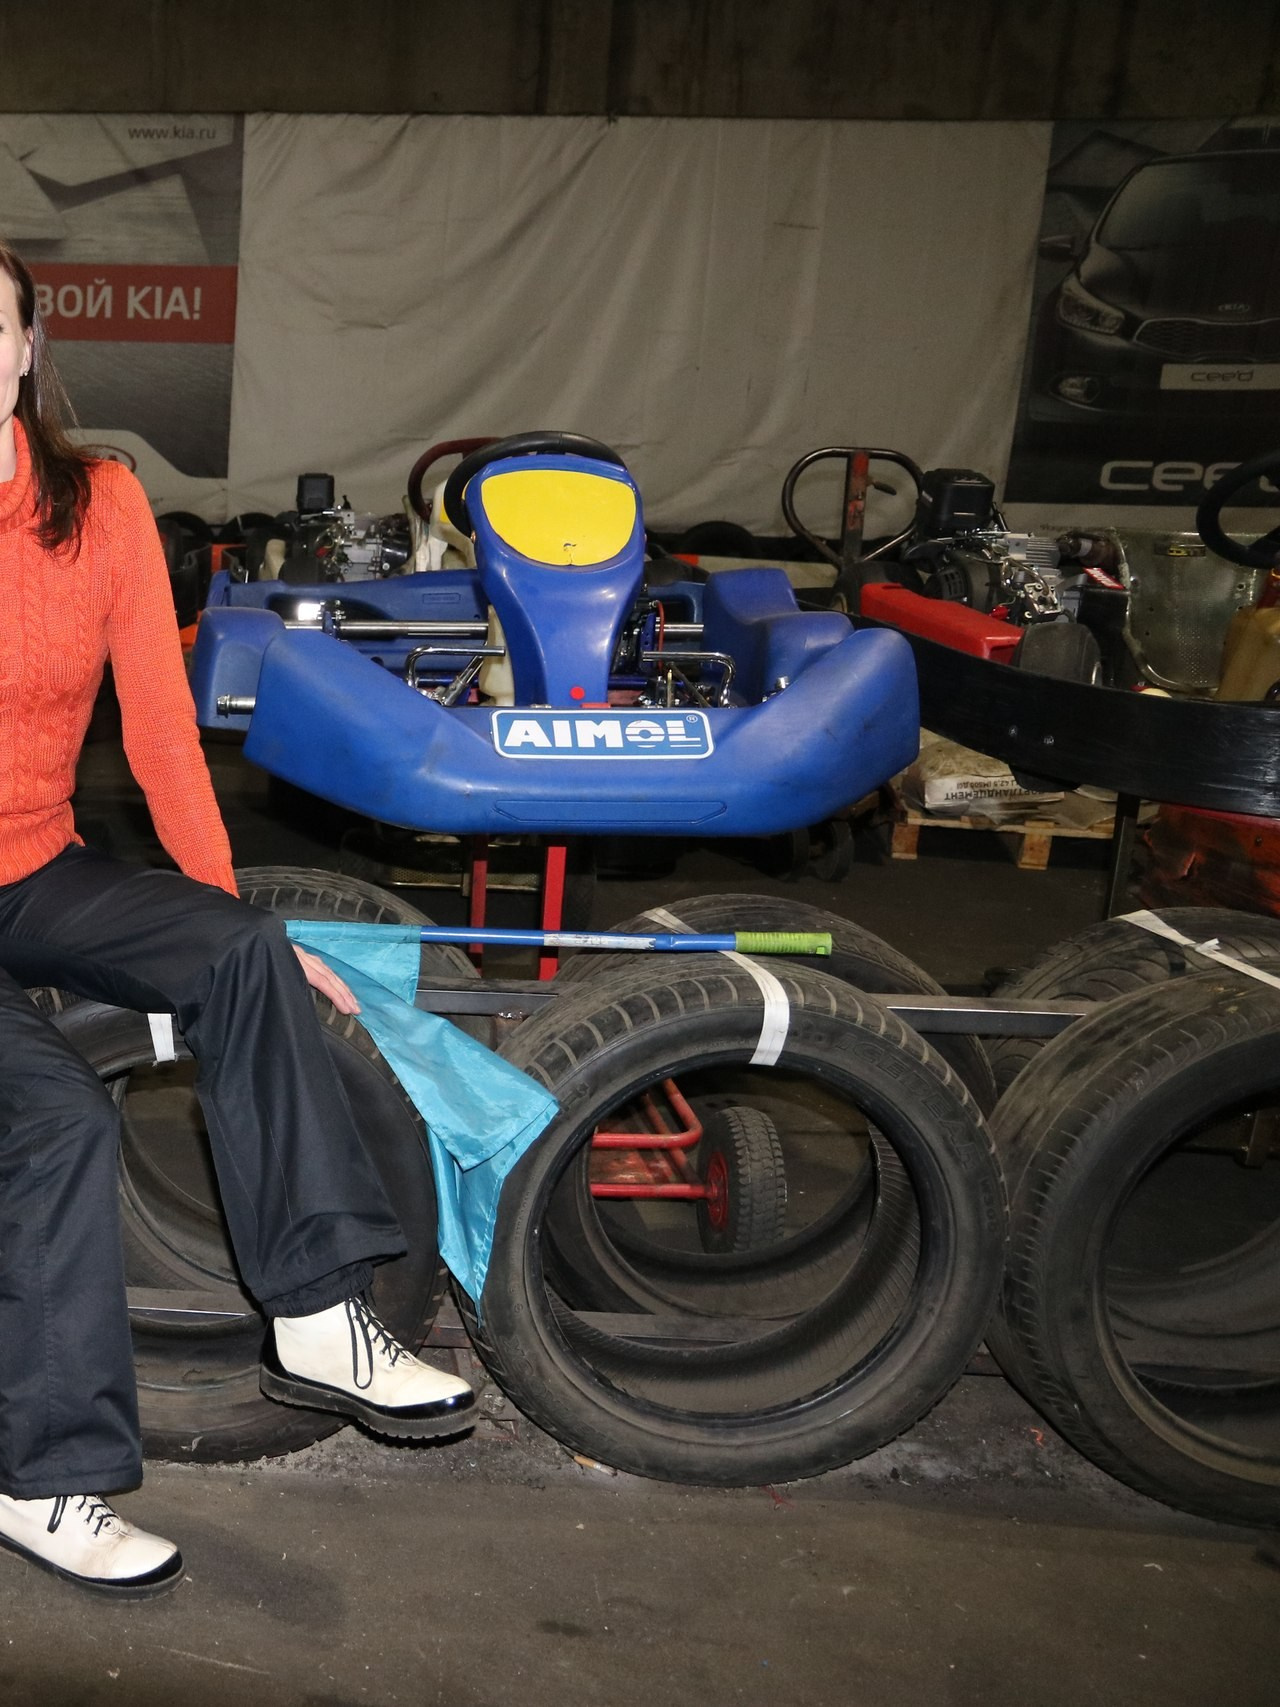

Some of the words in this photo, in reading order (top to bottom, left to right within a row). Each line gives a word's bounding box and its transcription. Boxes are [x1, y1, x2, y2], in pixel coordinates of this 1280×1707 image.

[127, 124, 217, 139] www.kia.ru
[127, 285, 202, 320] KIA!
[504, 720, 702, 748] AIMOL
